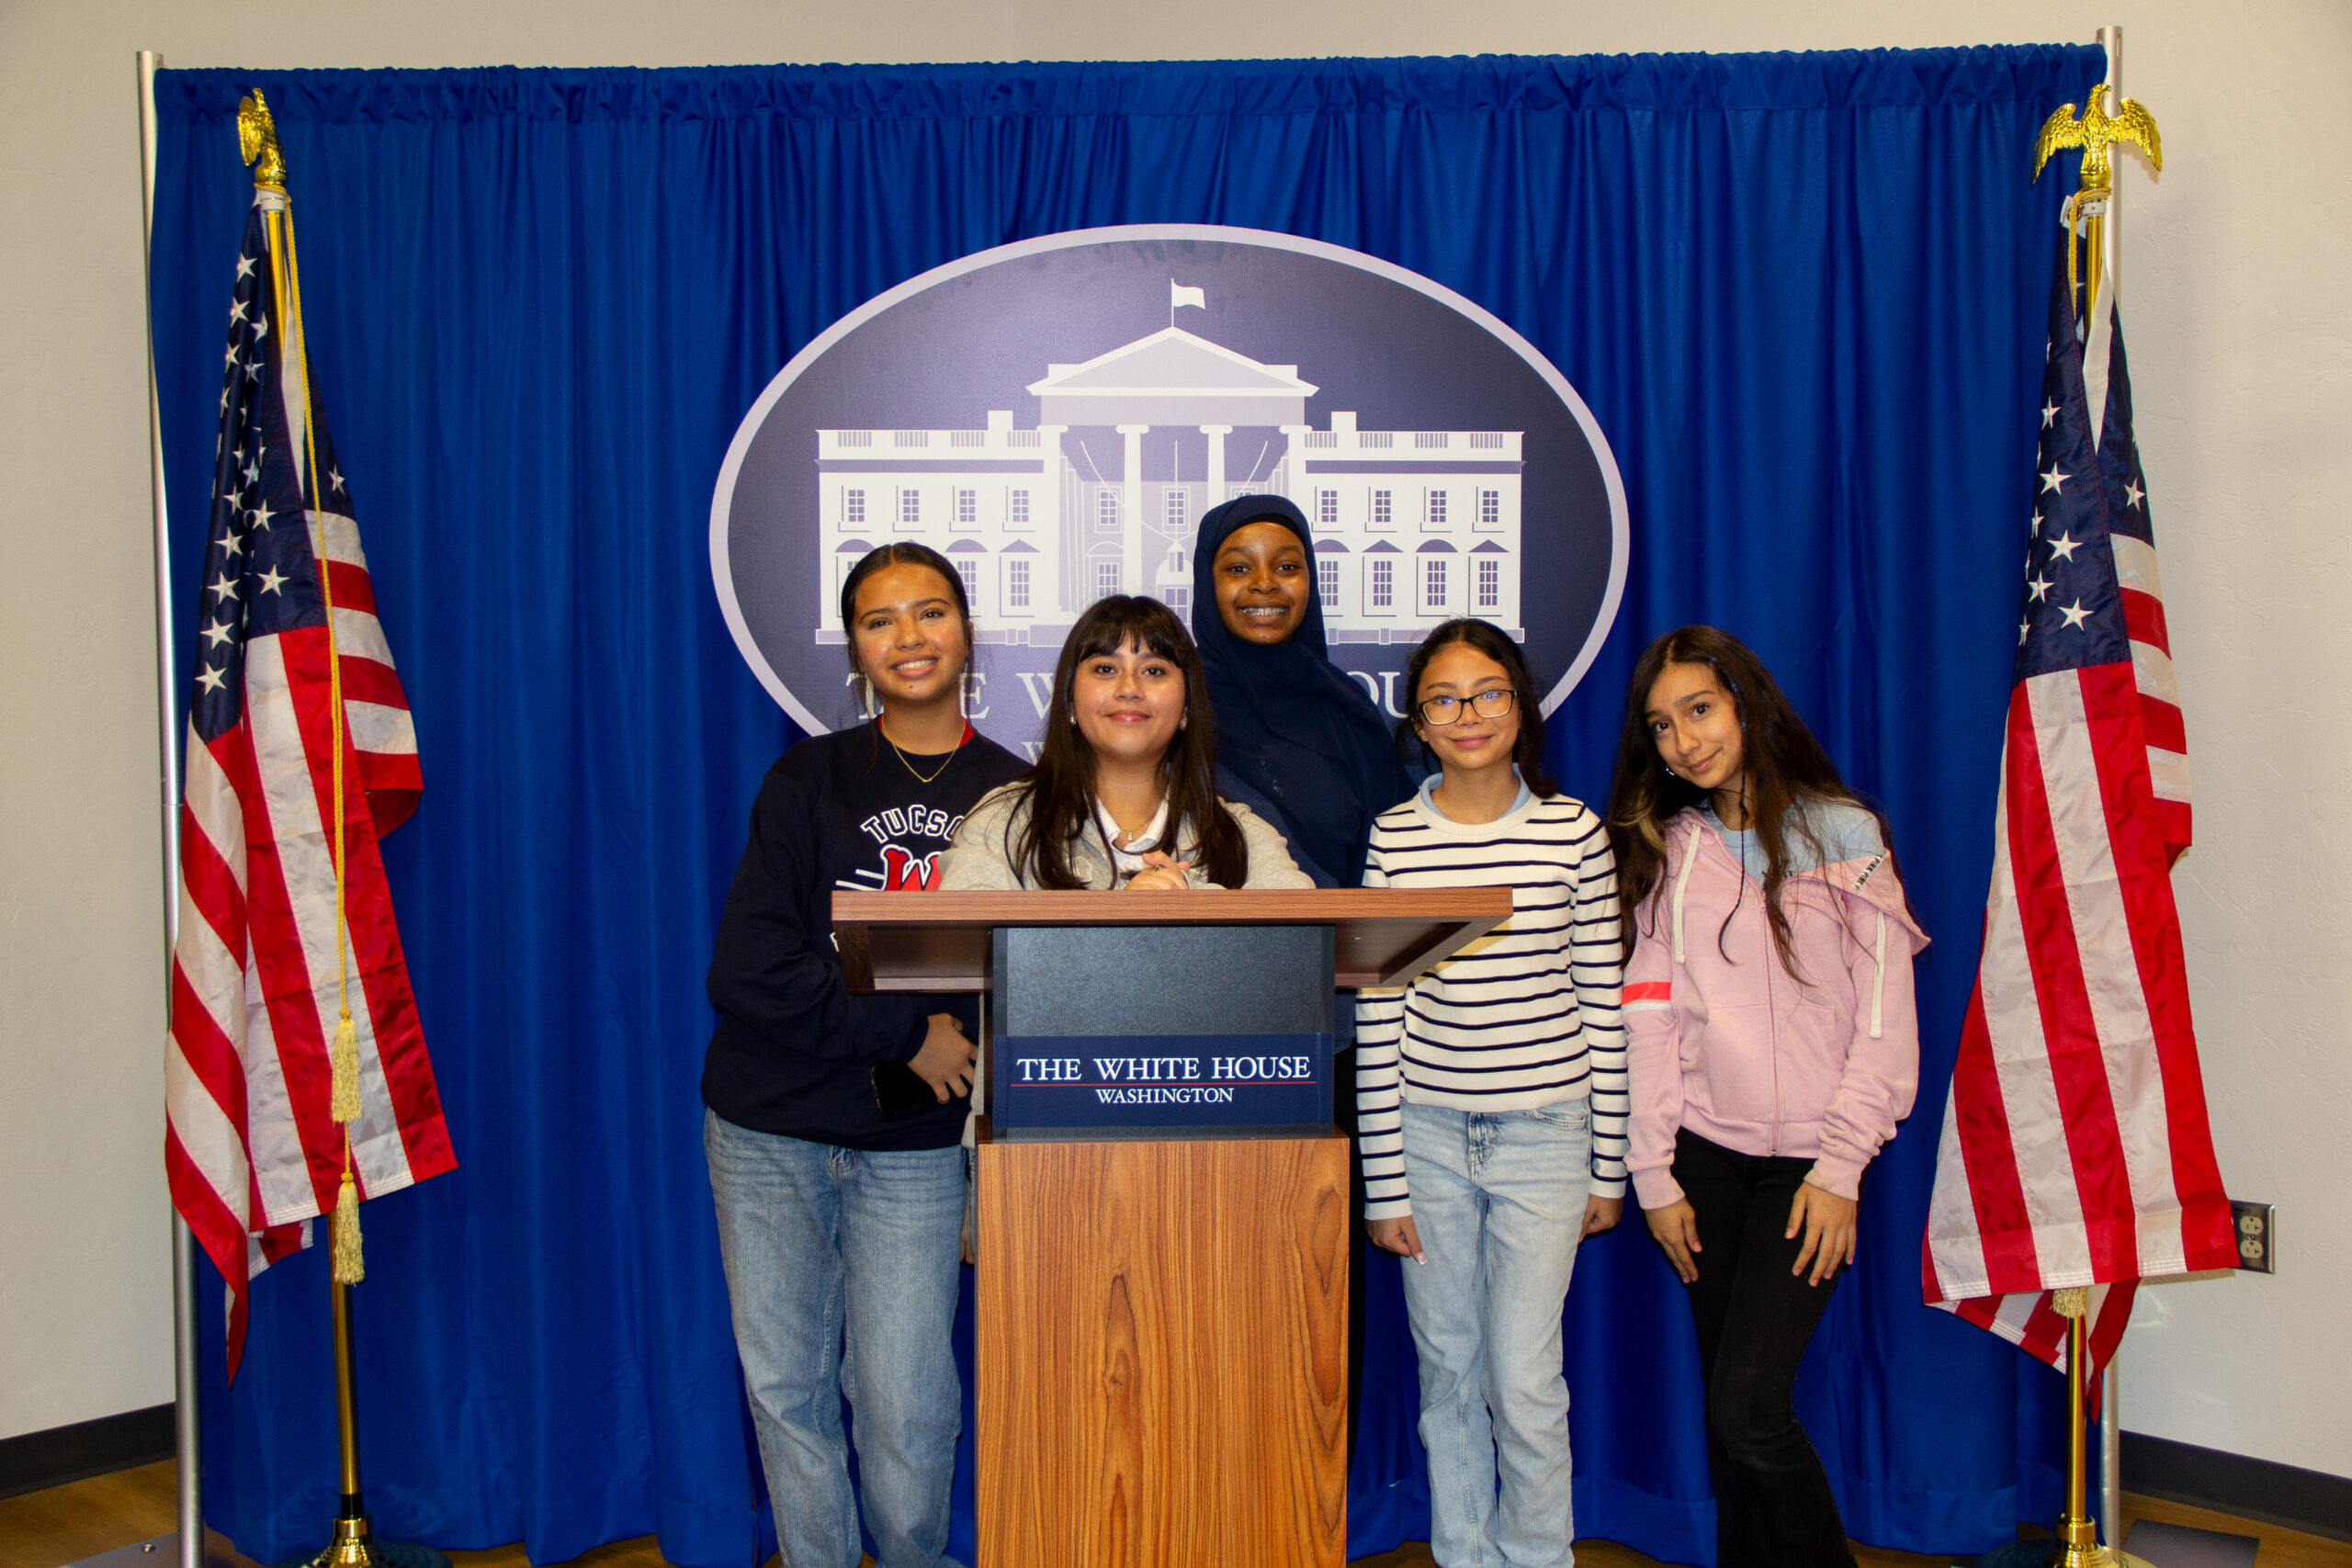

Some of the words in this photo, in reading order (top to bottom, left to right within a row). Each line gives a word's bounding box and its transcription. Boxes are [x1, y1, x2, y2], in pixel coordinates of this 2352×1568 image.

[845, 671, 990, 719] TE
[1016, 1058, 1082, 1081] THE
[1093, 1056, 1201, 1080] WHITE
[1211, 1055, 1311, 1079] HOUSE
[1095, 1087, 1235, 1105] WASHINGTON
